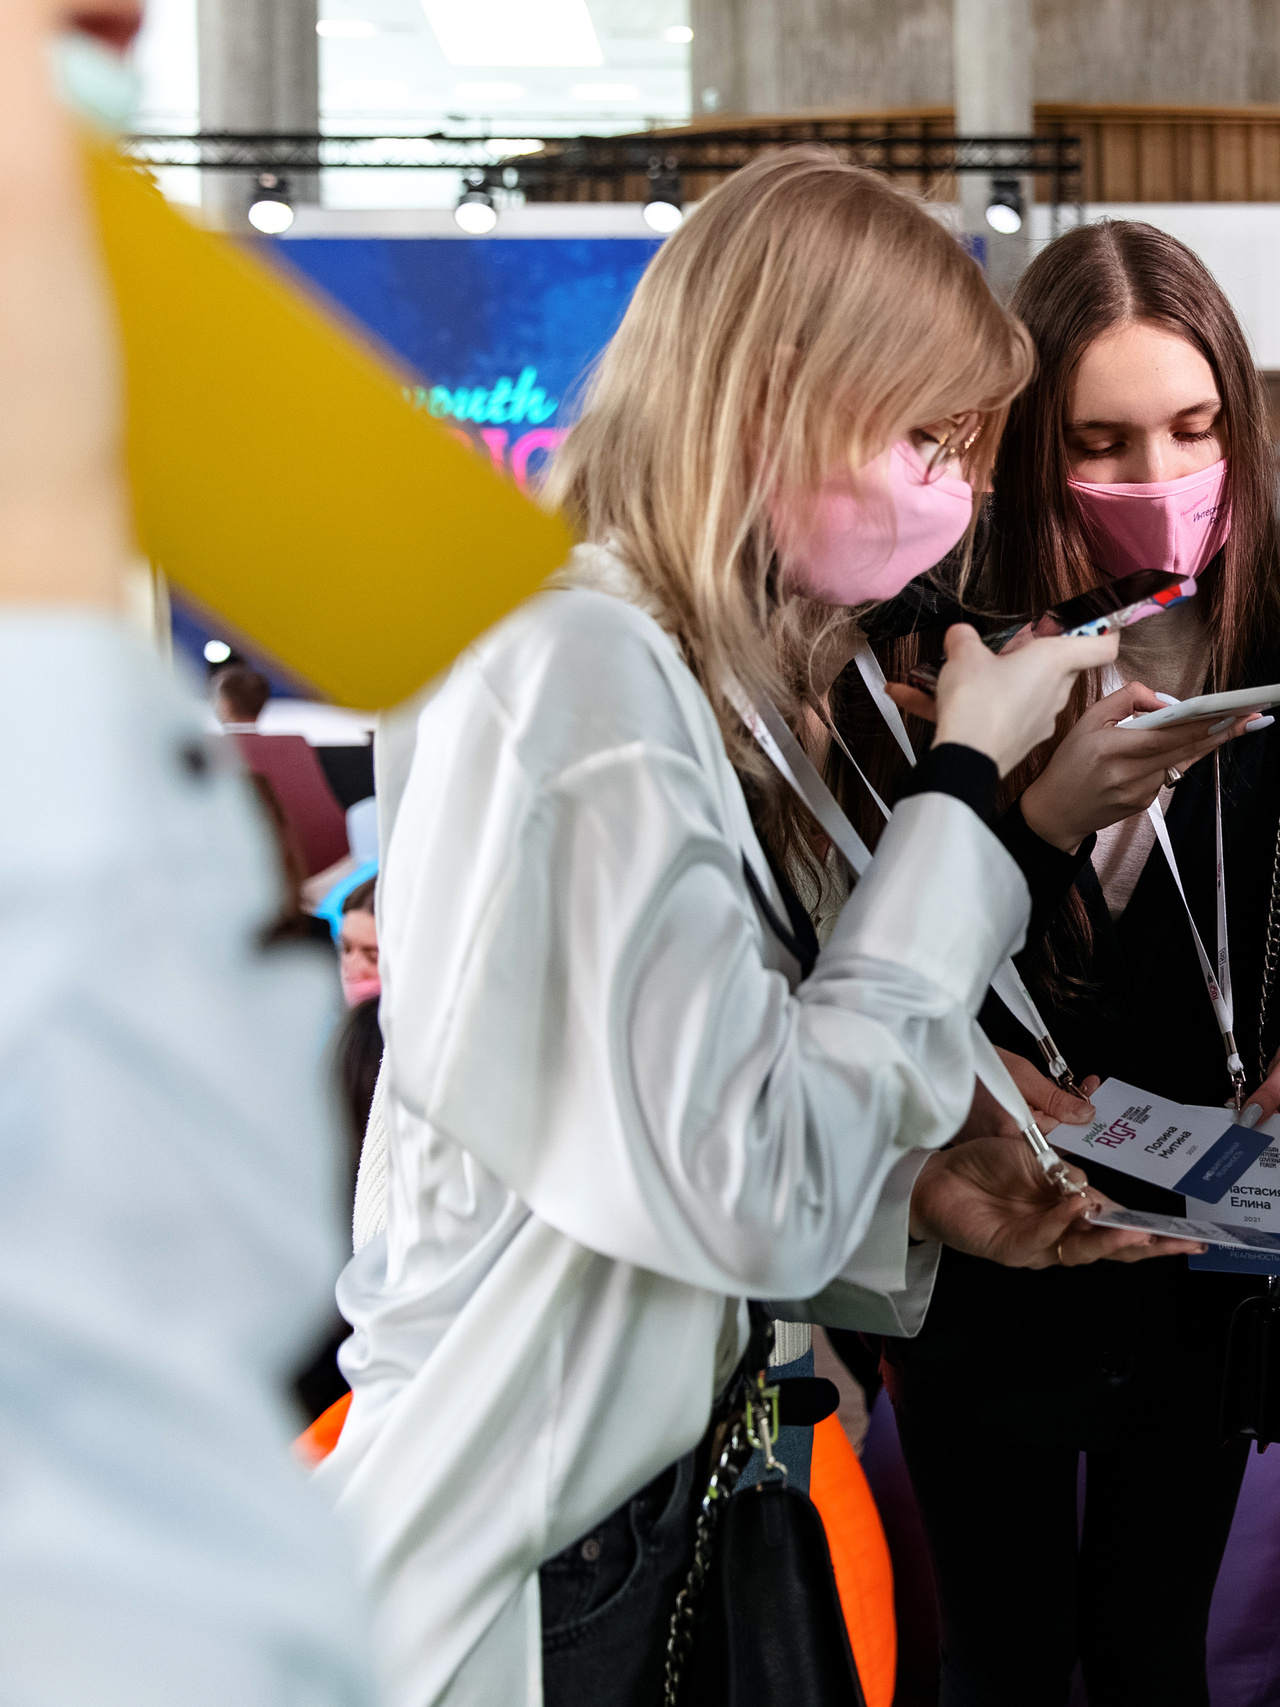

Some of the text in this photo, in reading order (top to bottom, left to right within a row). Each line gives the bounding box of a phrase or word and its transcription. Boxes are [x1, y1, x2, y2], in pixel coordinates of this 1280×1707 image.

[1081, 1121, 1107, 1148] youth
[1094, 1118, 1137, 1148] RIGF
[1143, 1125, 1178, 1154] Полина
[1158, 1130, 1192, 1159] Митина
[1230, 1196, 1271, 1210] Елина
[1230, 1251, 1280, 1262] РЕАЛЬНОСТЬ
